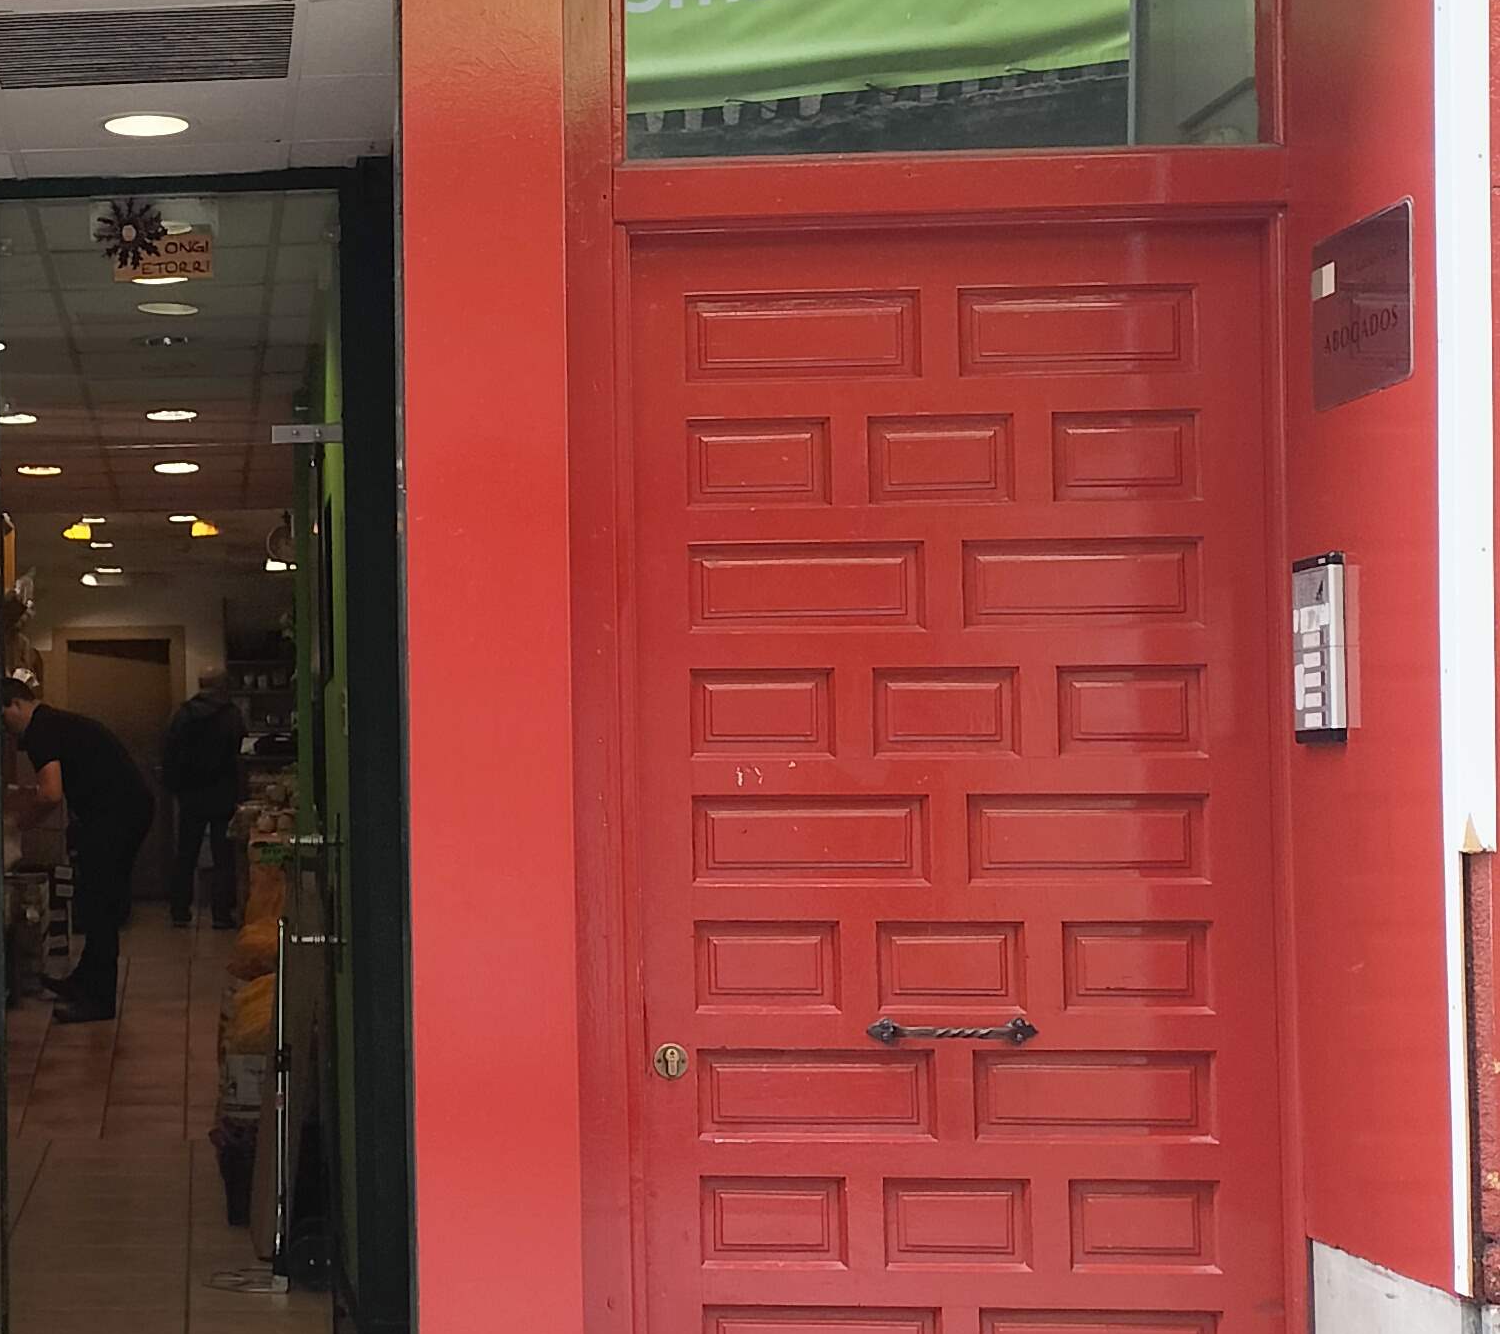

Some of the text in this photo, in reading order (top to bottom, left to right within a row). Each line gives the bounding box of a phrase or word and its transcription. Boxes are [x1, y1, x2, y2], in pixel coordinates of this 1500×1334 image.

[164, 240, 209, 255] ONGI
[141, 260, 210, 275] ETORRI
[1323, 304, 1399, 355] ABOGADOS
